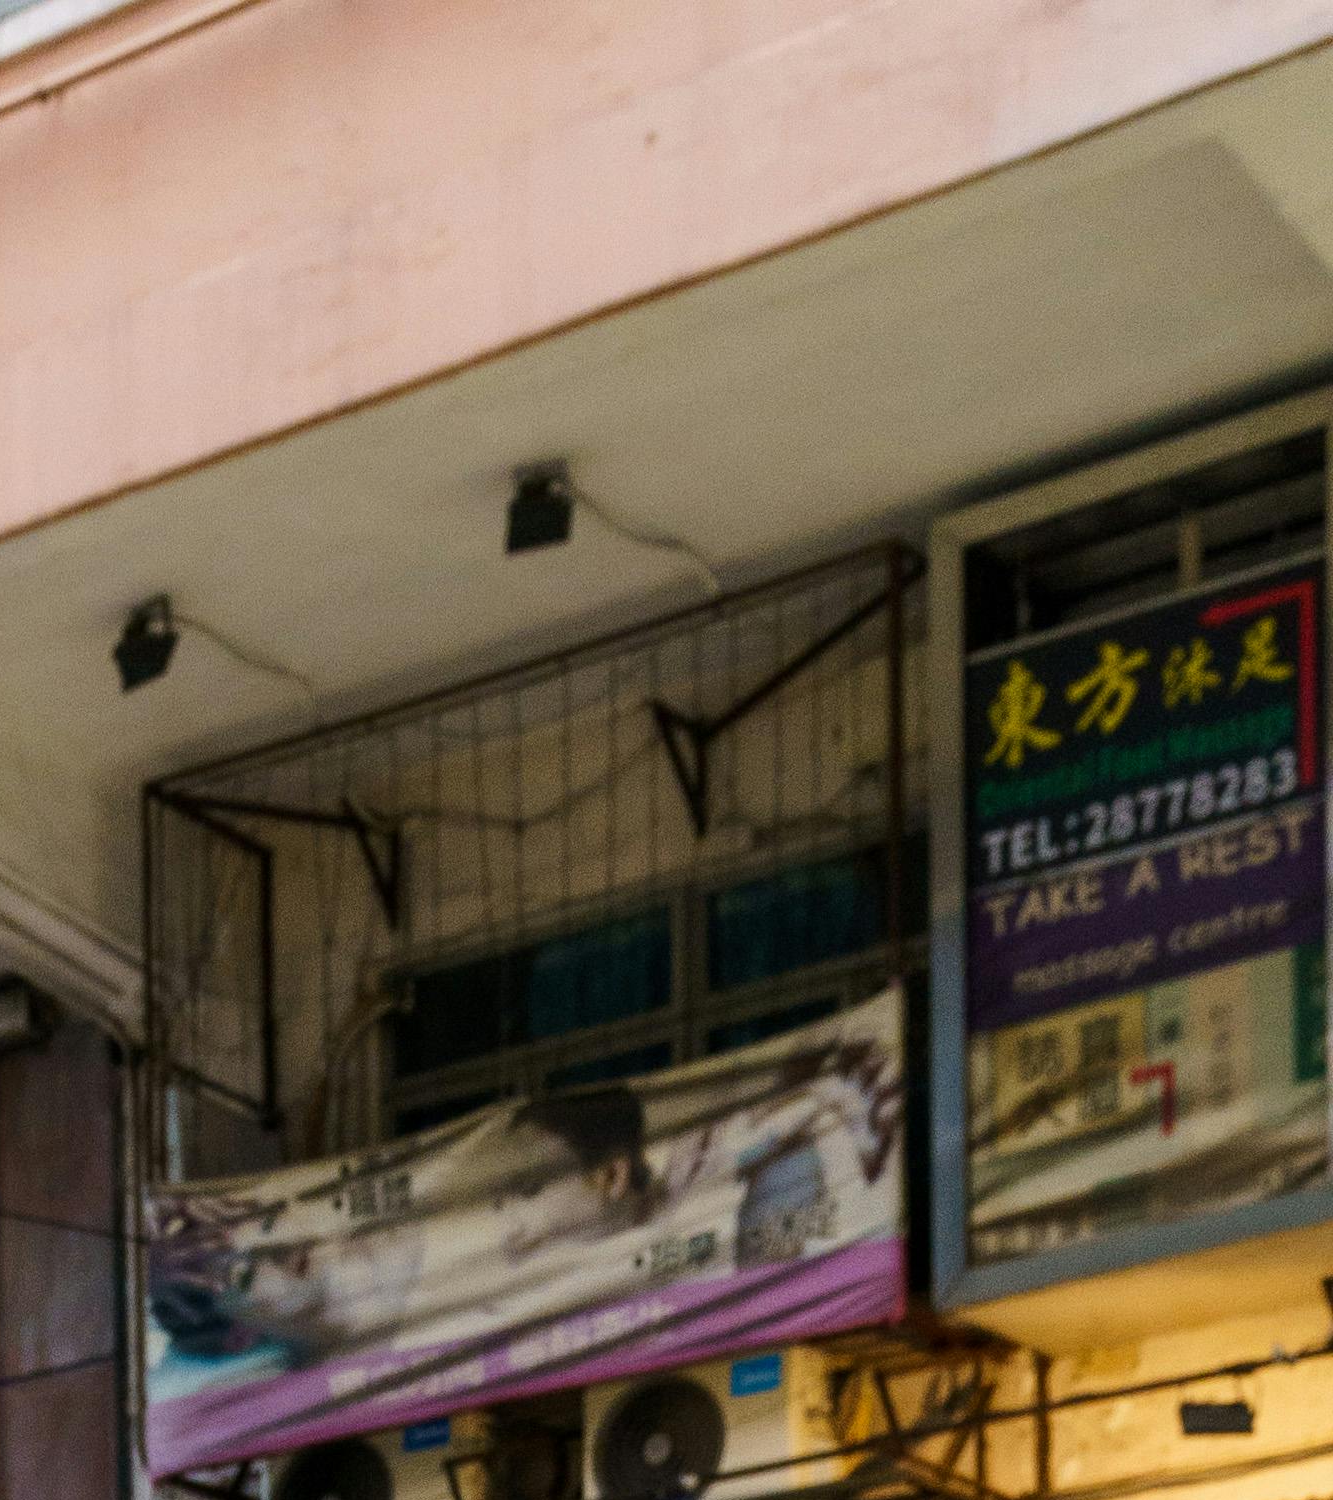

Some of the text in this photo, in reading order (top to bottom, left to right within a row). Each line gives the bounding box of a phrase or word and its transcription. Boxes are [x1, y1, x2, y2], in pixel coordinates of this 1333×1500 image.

[986, 805, 1311, 937] TAKE A REST
